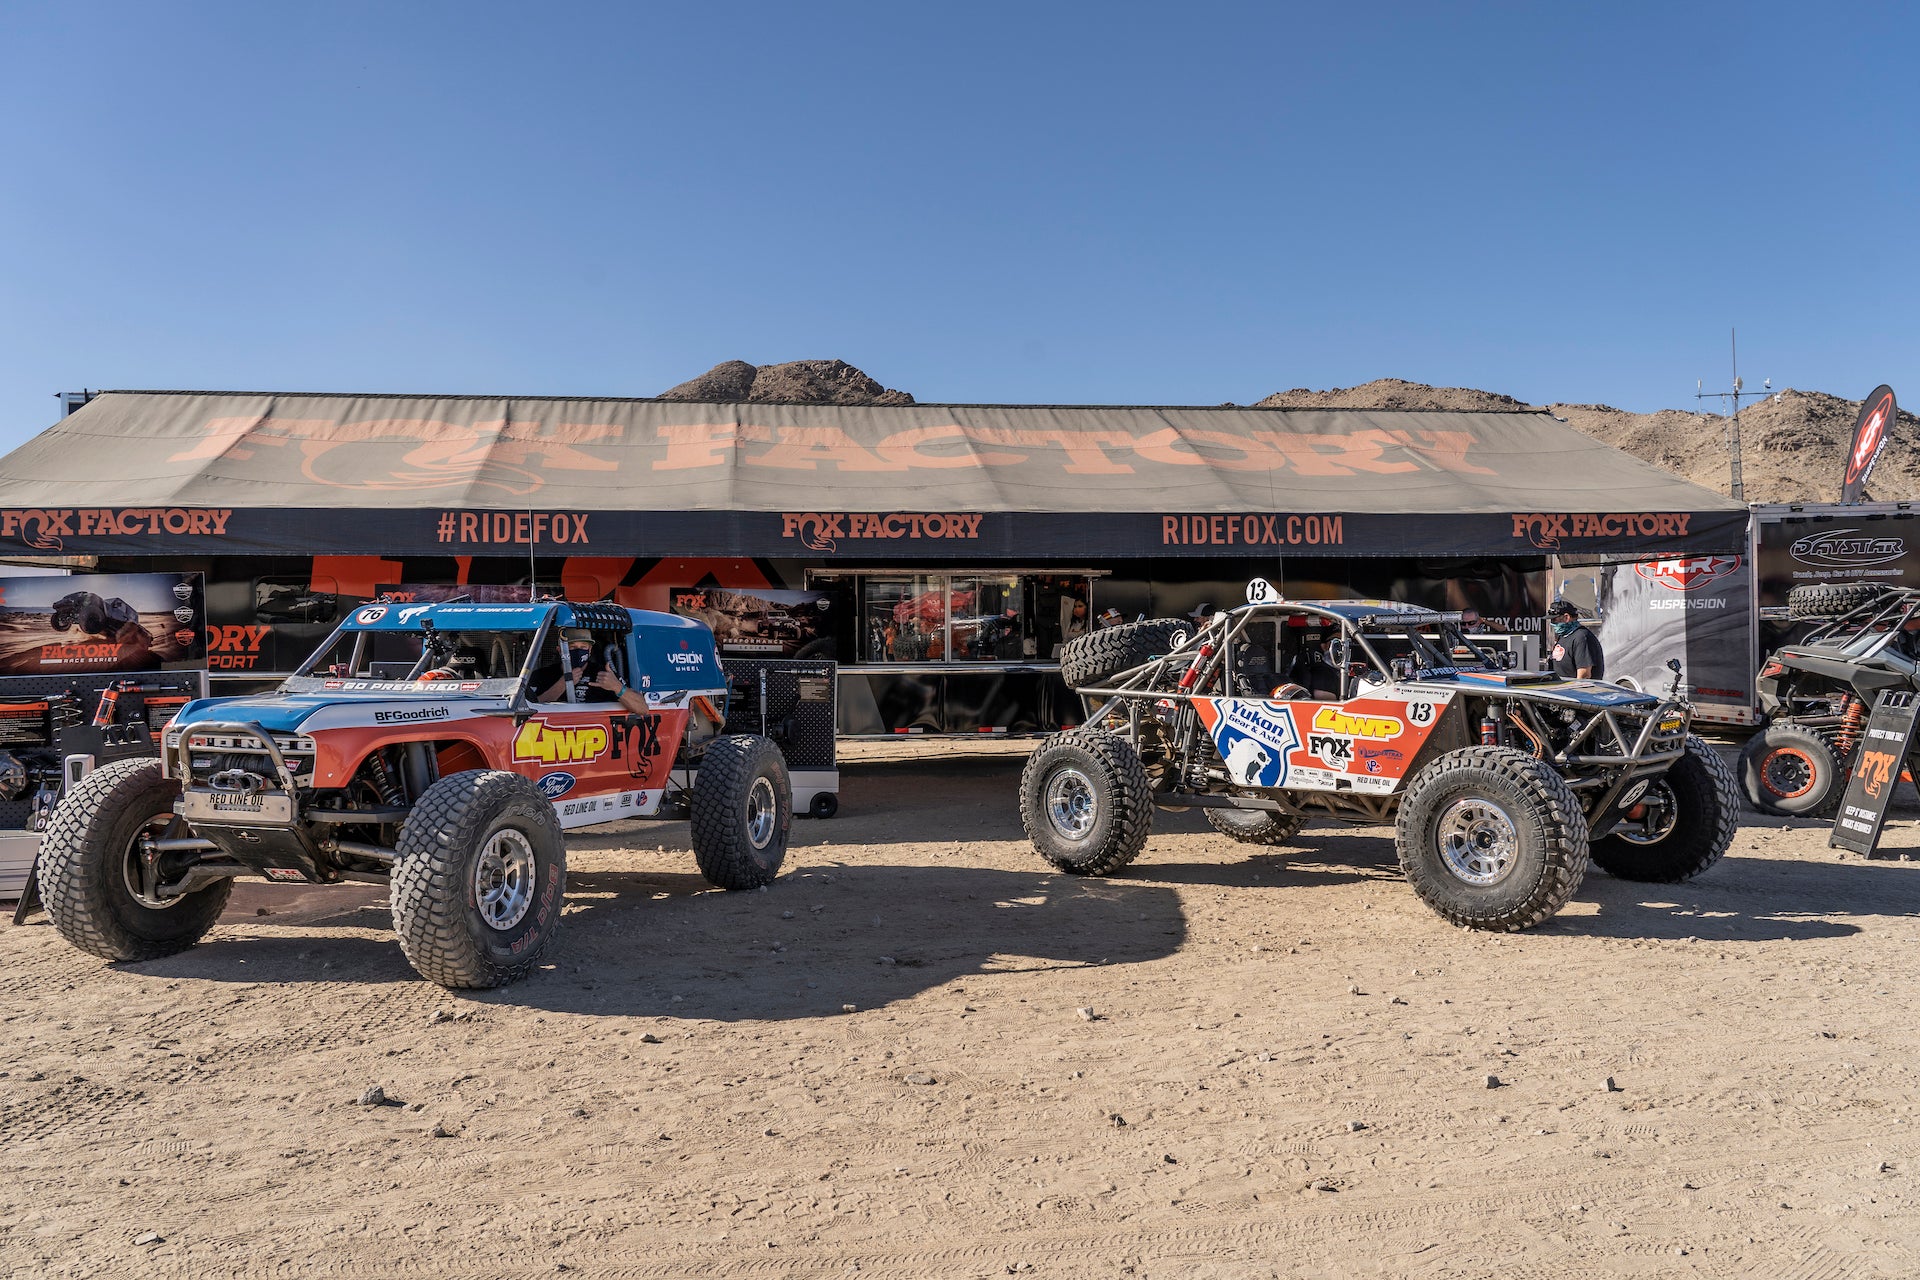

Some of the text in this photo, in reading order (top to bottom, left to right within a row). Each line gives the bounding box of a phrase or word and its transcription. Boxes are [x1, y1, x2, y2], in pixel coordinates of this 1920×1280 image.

[165, 416, 1499, 496] FOX FACTORY
[1, 509, 232, 551] FOX FACTORY
[437, 512, 590, 544] #RIDEFOX
[781, 513, 983, 554] FOX FACTORY
[1162, 515, 1344, 545] RIDEFOX.COM
[1512, 513, 1691, 551] FOX FACTORY
[1793, 538, 1904, 556] DAYSTAR
[1250, 581, 1267, 601] 13
[362, 609, 384, 620] 76
[676, 594, 707, 614] FOX
[1649, 598, 1727, 610] SUSPENSION
[40, 643, 122, 659] FACTORY
[667, 651, 704, 664] VISION
[343, 682, 460, 691] GO PREPARED
[642, 675, 651, 688] 76
[375, 706, 449, 721] BFGoodrich
[1231, 700, 1285, 738] Yukon
[1410, 702, 1432, 722] 13
[1228, 714, 1281, 745] Gear & Axle
[1315, 708, 1401, 738] 4WP
[514, 721, 608, 763] 4WP
[609, 714, 662, 781] FOX
[1309, 736, 1352, 770] FOX
[540, 774, 570, 797] Ford
[1356, 776, 1391, 787] RED LINE OIL
[1857, 751, 1897, 800] FOX
[209, 793, 265, 806] RED LINE OIL
[563, 804, 578, 816] RED
[576, 802, 590, 815] LINE
[588, 800, 598, 812] OIL
